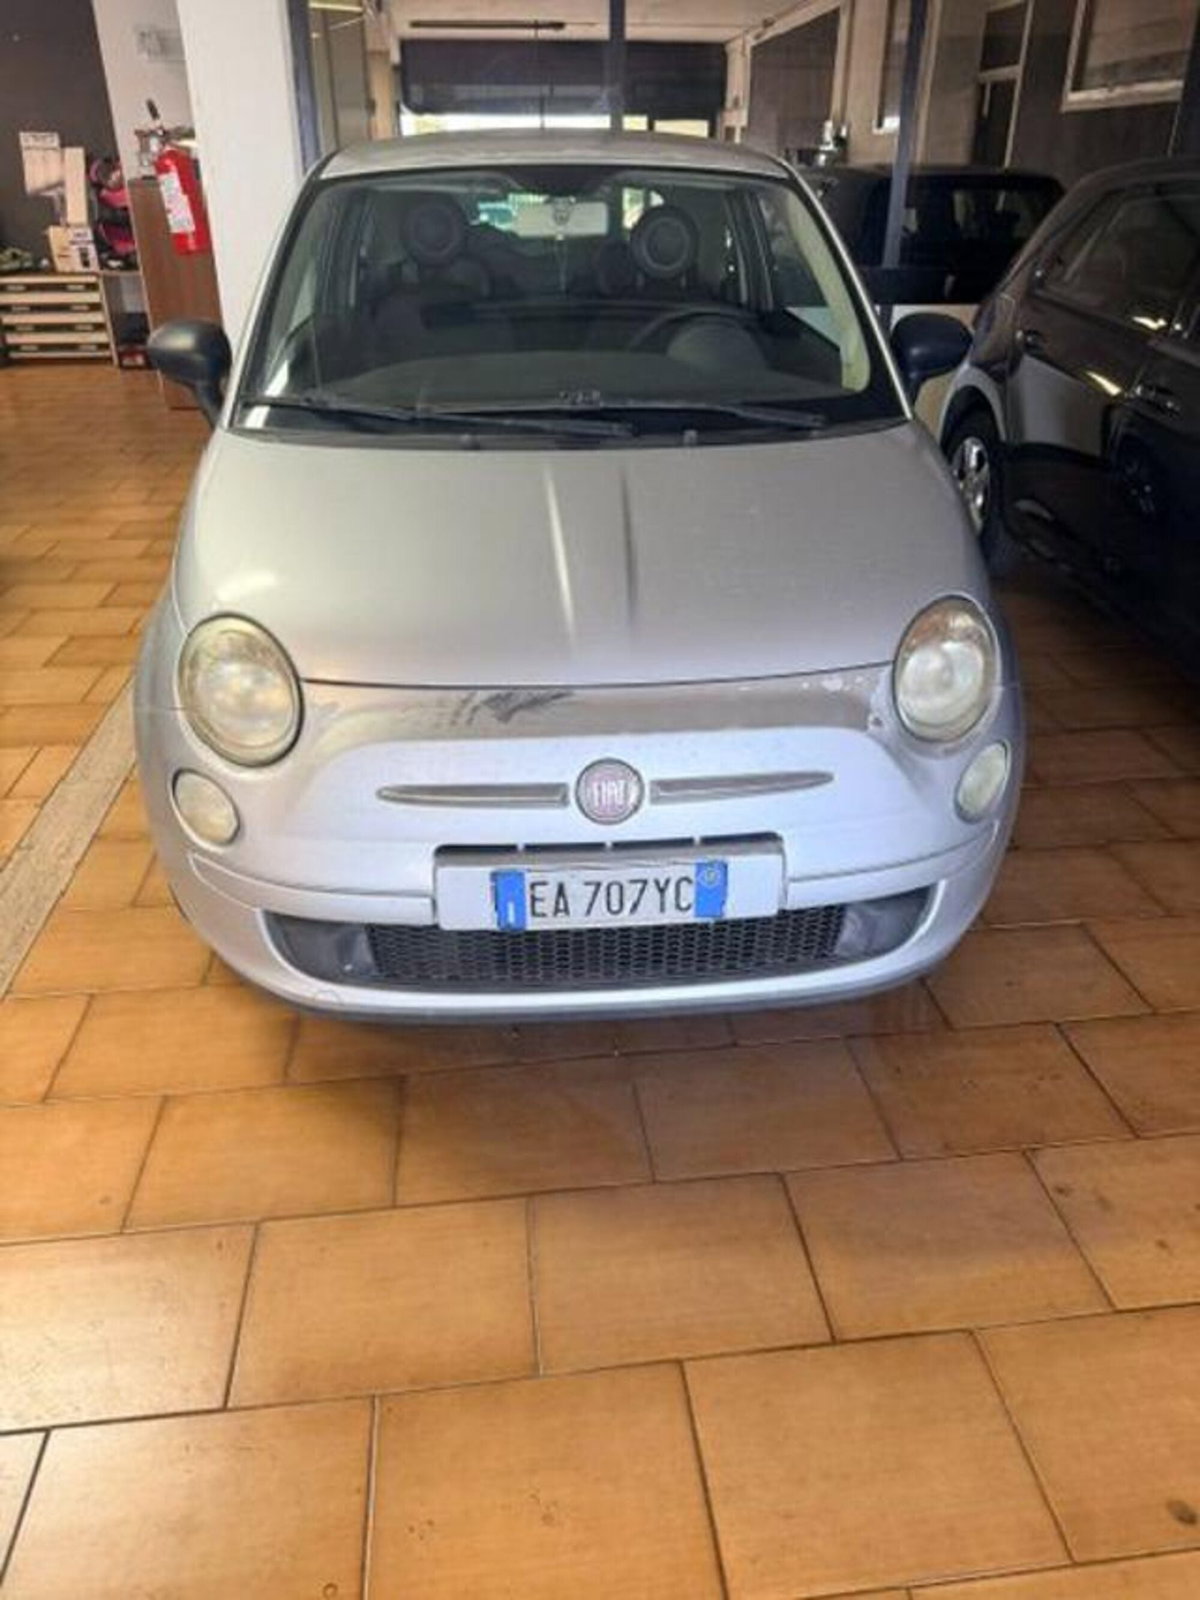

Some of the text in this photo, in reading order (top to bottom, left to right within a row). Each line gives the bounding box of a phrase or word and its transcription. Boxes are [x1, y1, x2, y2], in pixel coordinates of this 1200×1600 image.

[592, 779, 626, 808] FIAT
[530, 877, 693, 917] EA 707YC
